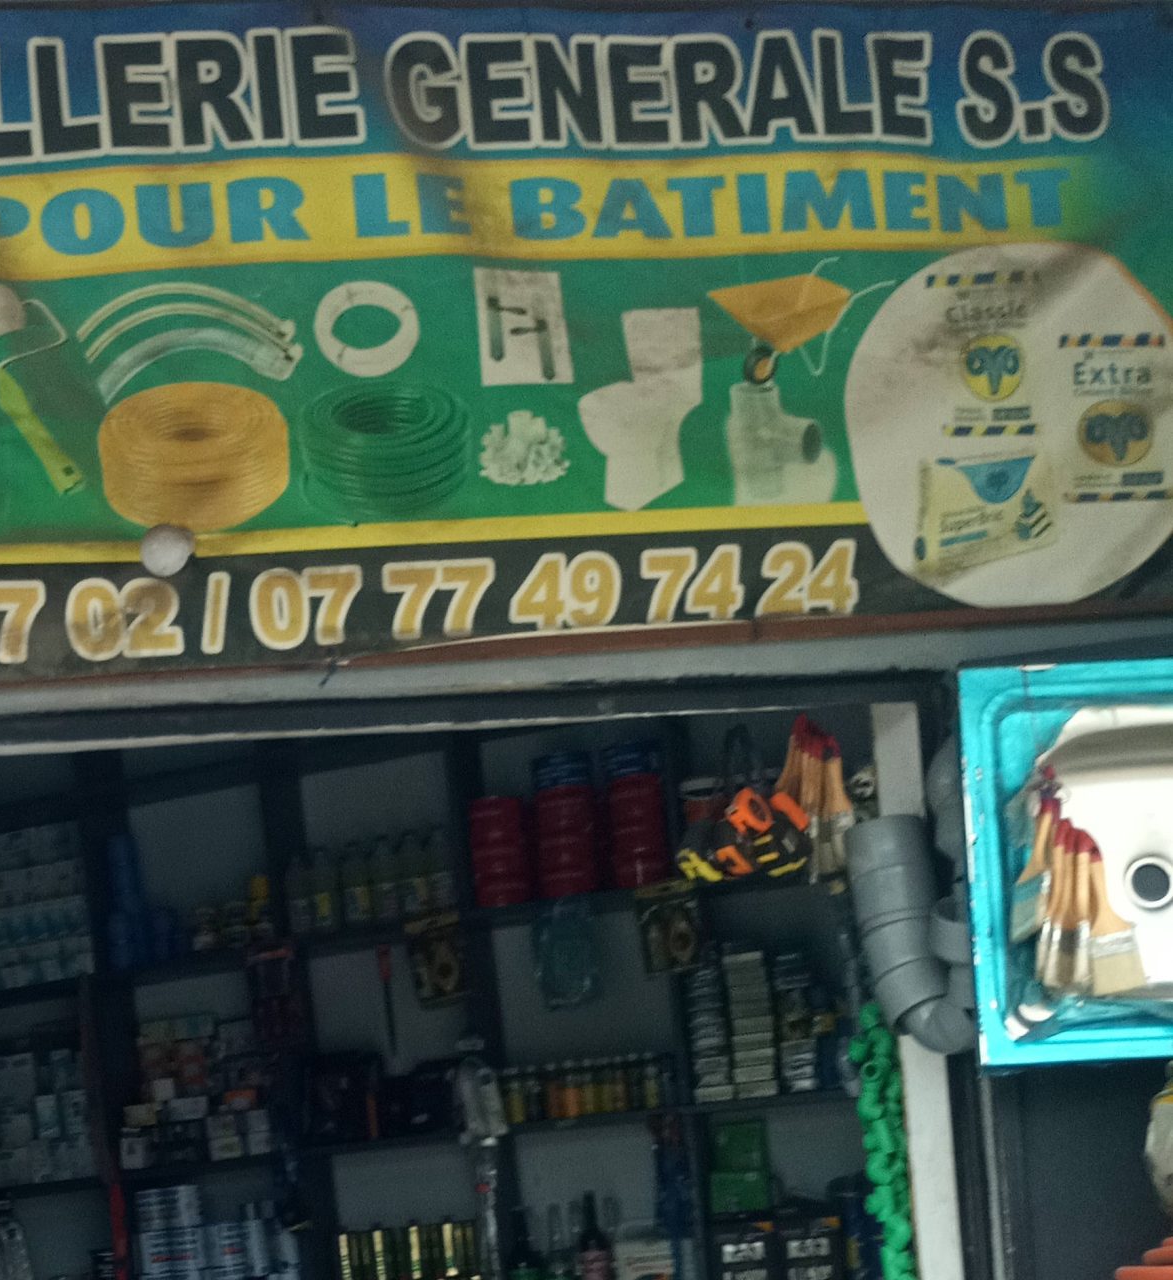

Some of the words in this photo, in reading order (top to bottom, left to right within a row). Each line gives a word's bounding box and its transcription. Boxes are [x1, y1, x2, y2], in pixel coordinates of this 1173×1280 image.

[383, 29, 933, 150] GENERALE
[957, 30, 1113, 148] S.S
[351, 172, 474, 238] LE
[509, 167, 1073, 242] BATIMENT
[1073, 362, 1153, 385] Extra
[66, 577, 185, 661] 02
[249, 565, 362, 650] 07
[381, 558, 496, 642] 77
[509, 551, 622, 631] 49
[640, 543, 745, 624] 74
[755, 538, 860, 618] 24
